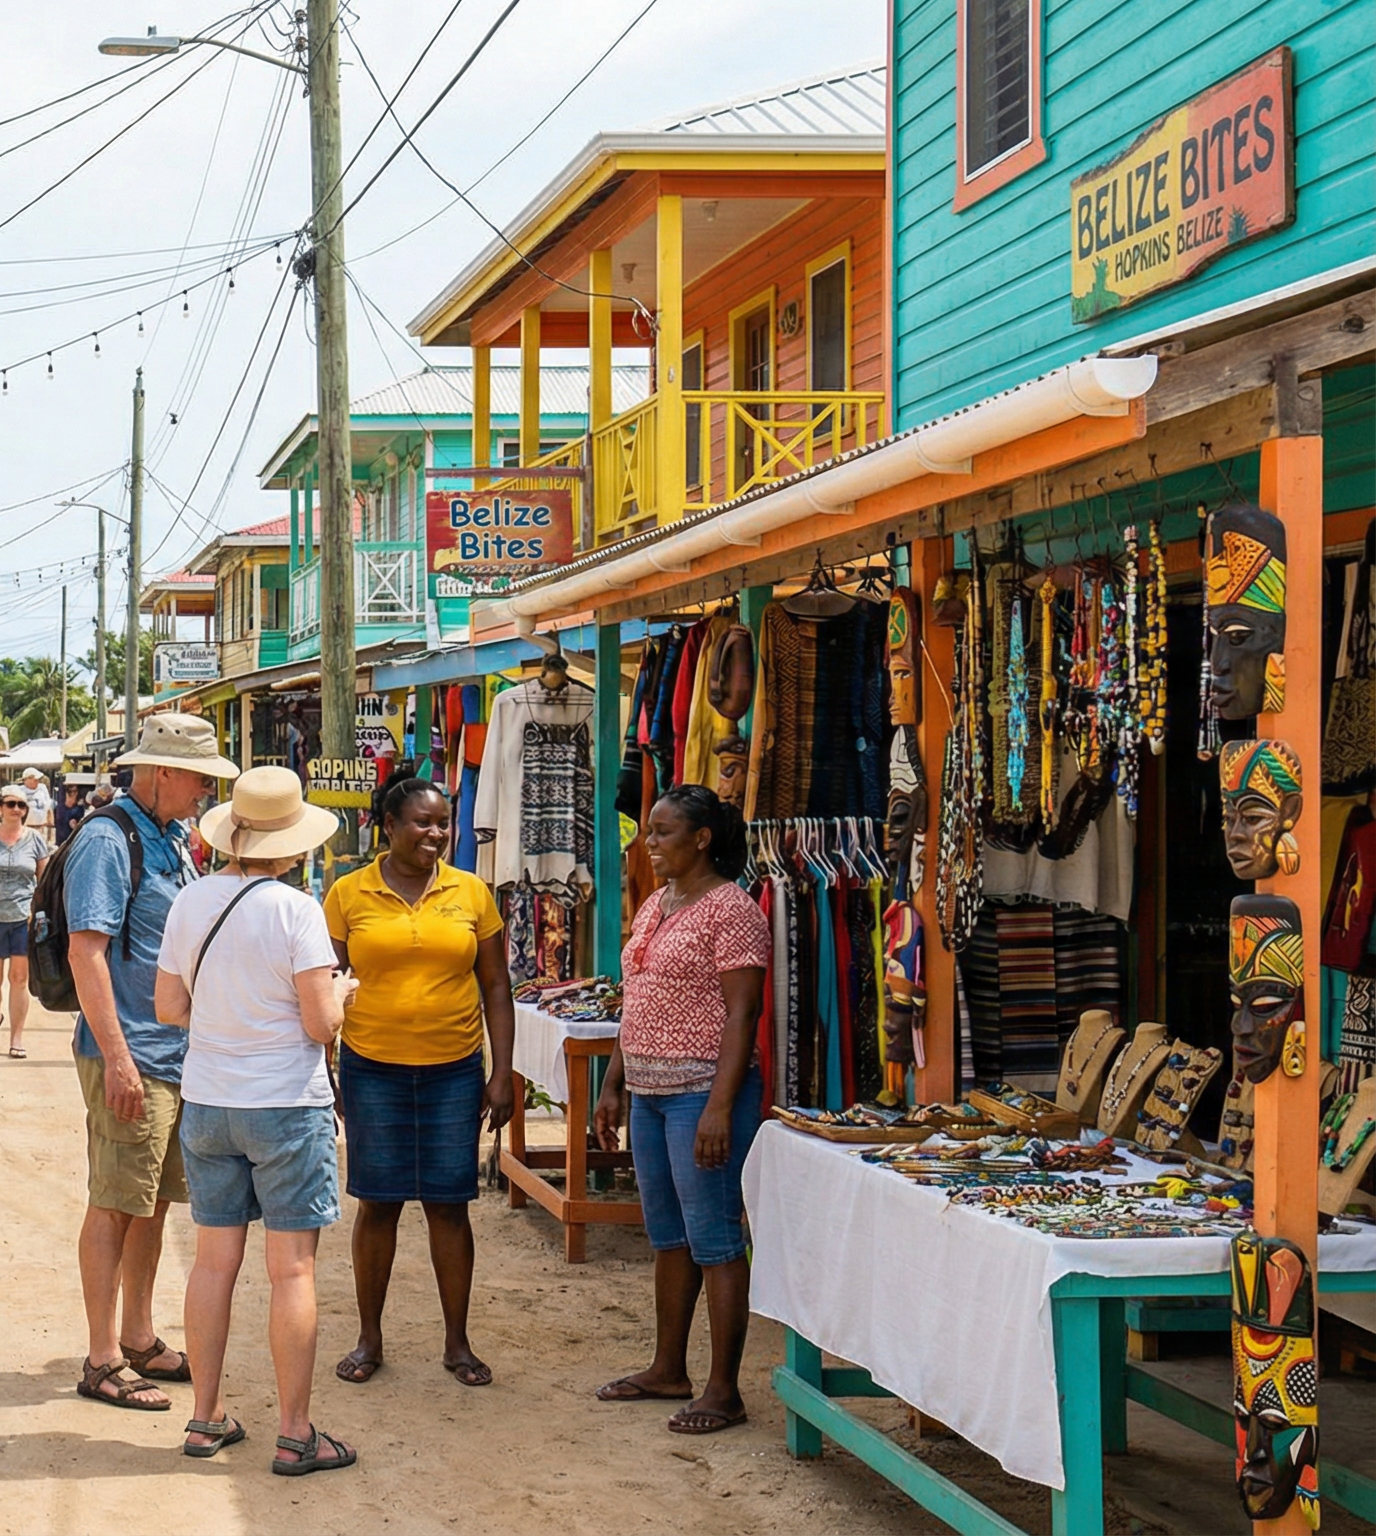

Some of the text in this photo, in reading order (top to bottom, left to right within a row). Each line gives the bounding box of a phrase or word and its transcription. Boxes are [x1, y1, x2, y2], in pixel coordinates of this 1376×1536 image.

[1077, 95, 1275, 261] BELIZE BITES
[1114, 206, 1225, 283] HOPKINS BELIZE
[450, 498, 551, 528] Belize
[460, 532, 544, 560] Bites
